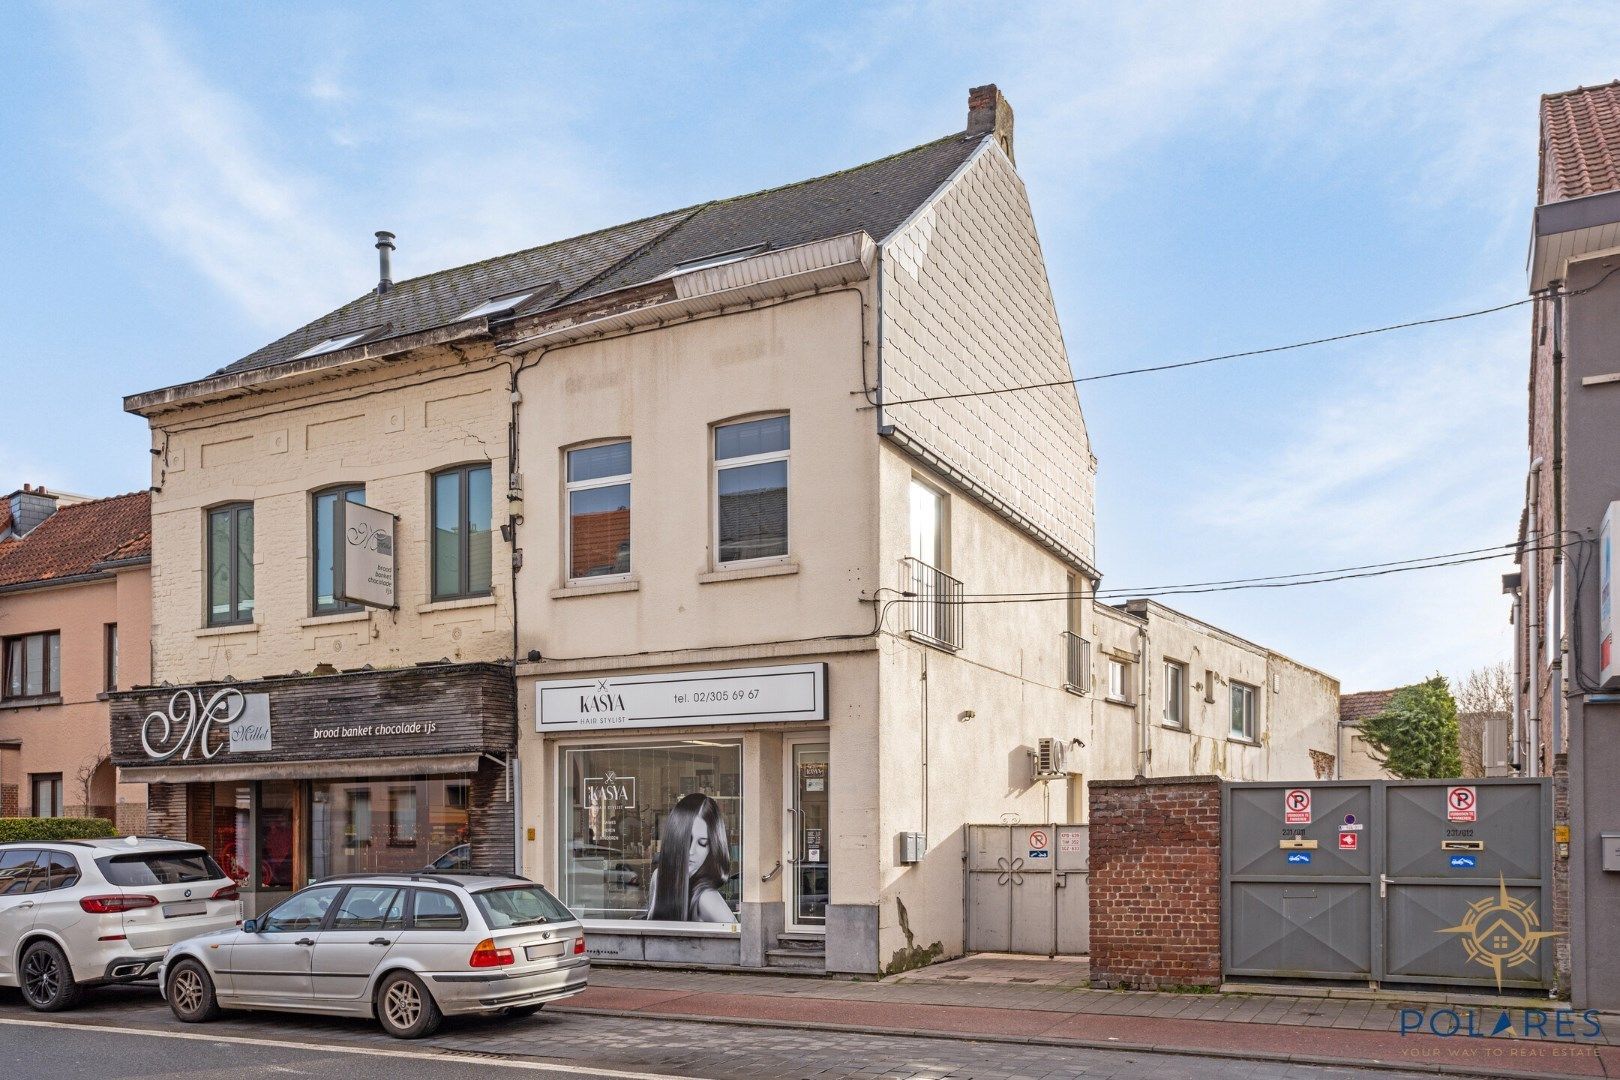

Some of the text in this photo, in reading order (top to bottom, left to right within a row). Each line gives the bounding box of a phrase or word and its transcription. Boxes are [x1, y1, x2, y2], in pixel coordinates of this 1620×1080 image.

[377, 564, 392, 573] brood
[375, 571, 392, 580] banket
[367, 577, 392, 588] chocolade
[673, 688, 760, 704] tel. 02/305 69 67
[580, 693, 626, 713] KASYA
[580, 716, 627, 725] HAIR STYLIST
[313, 721, 437, 739] brood banket chocolade ijs
